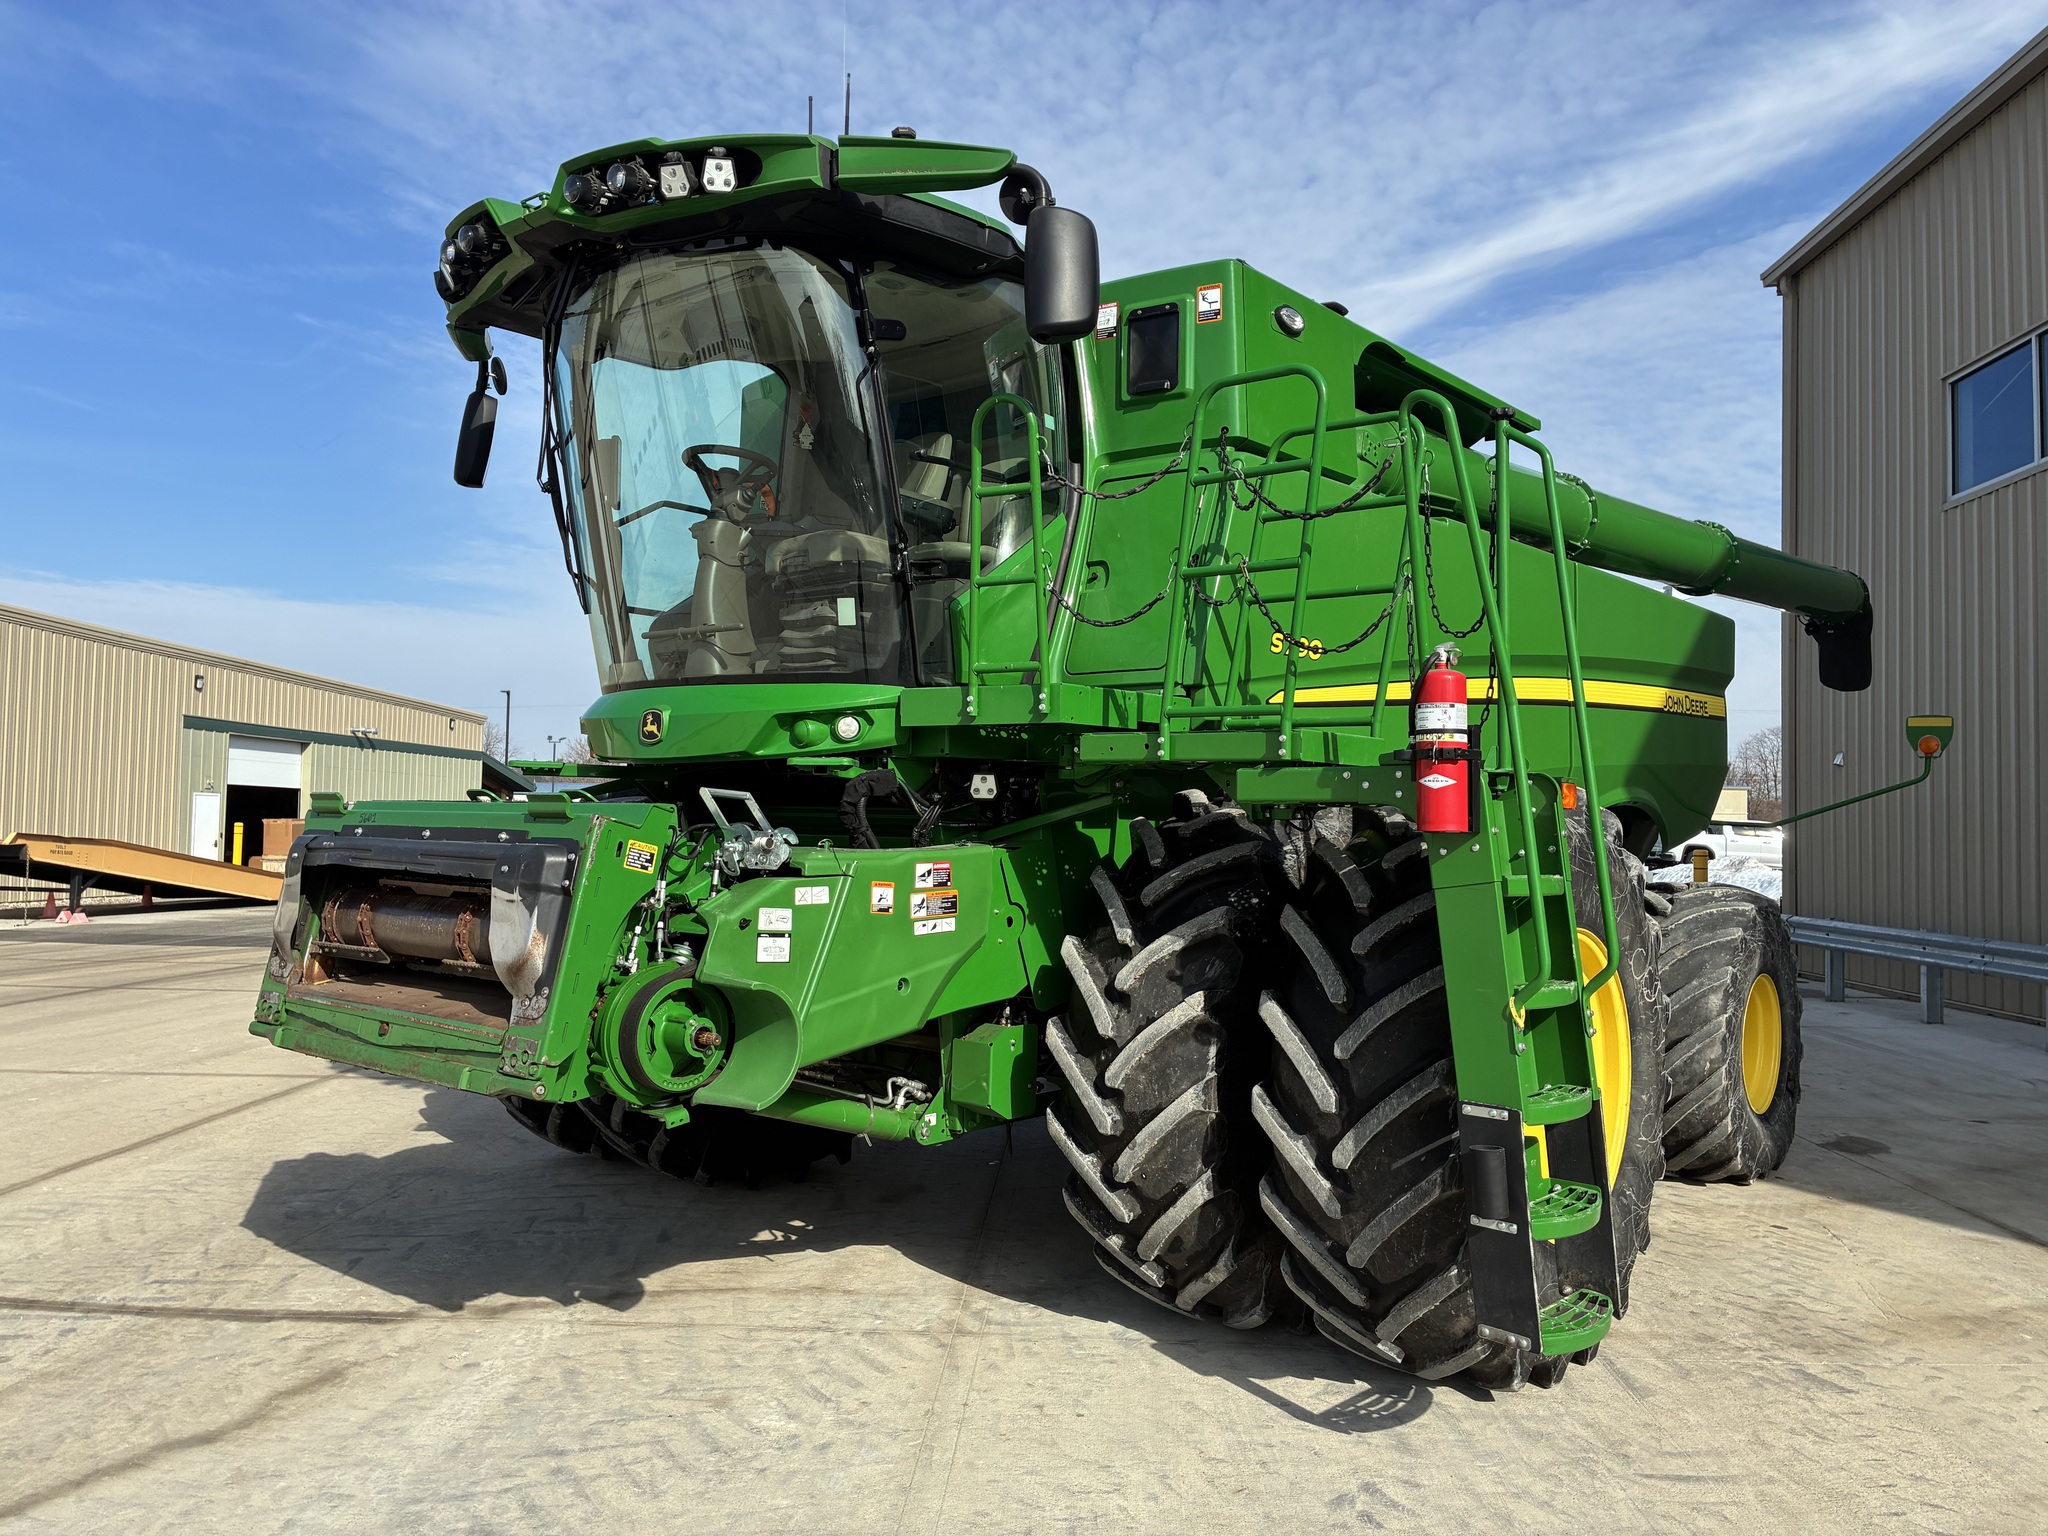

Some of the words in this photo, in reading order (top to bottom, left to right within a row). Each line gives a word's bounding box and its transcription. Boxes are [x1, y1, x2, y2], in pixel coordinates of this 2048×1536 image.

[1663, 691, 1685, 713] JOHN
[1684, 694, 1709, 716] DEERE
[633, 842, 657, 852] CAUTION
